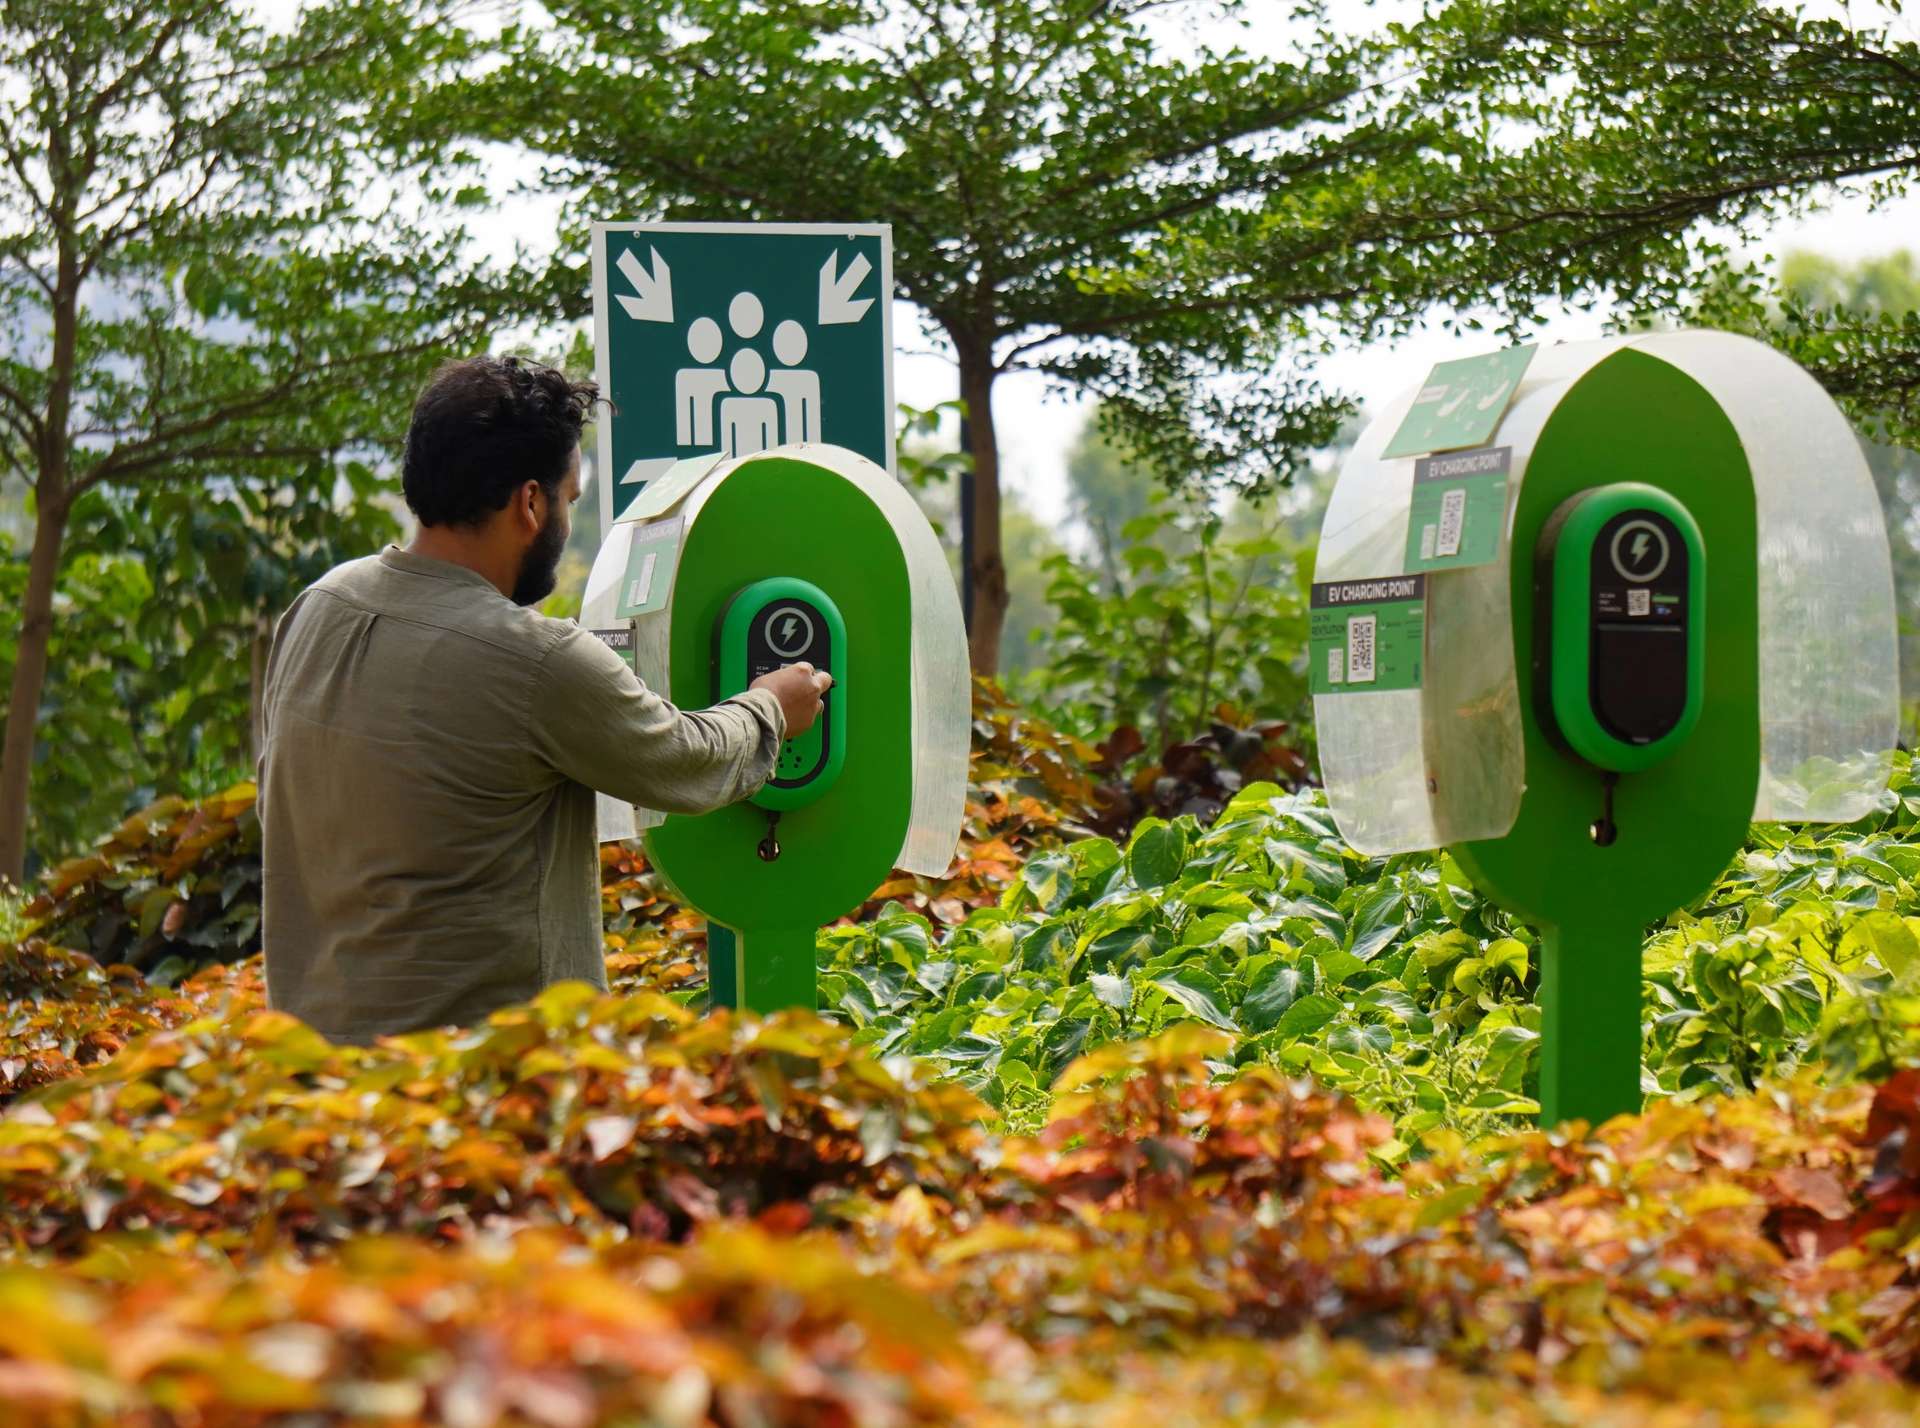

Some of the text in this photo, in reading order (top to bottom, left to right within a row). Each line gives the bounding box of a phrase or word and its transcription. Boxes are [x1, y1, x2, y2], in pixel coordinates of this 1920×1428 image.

[1328, 580, 1416, 602] EV CHARGING POINT
[614, 633, 629, 646] POINT
